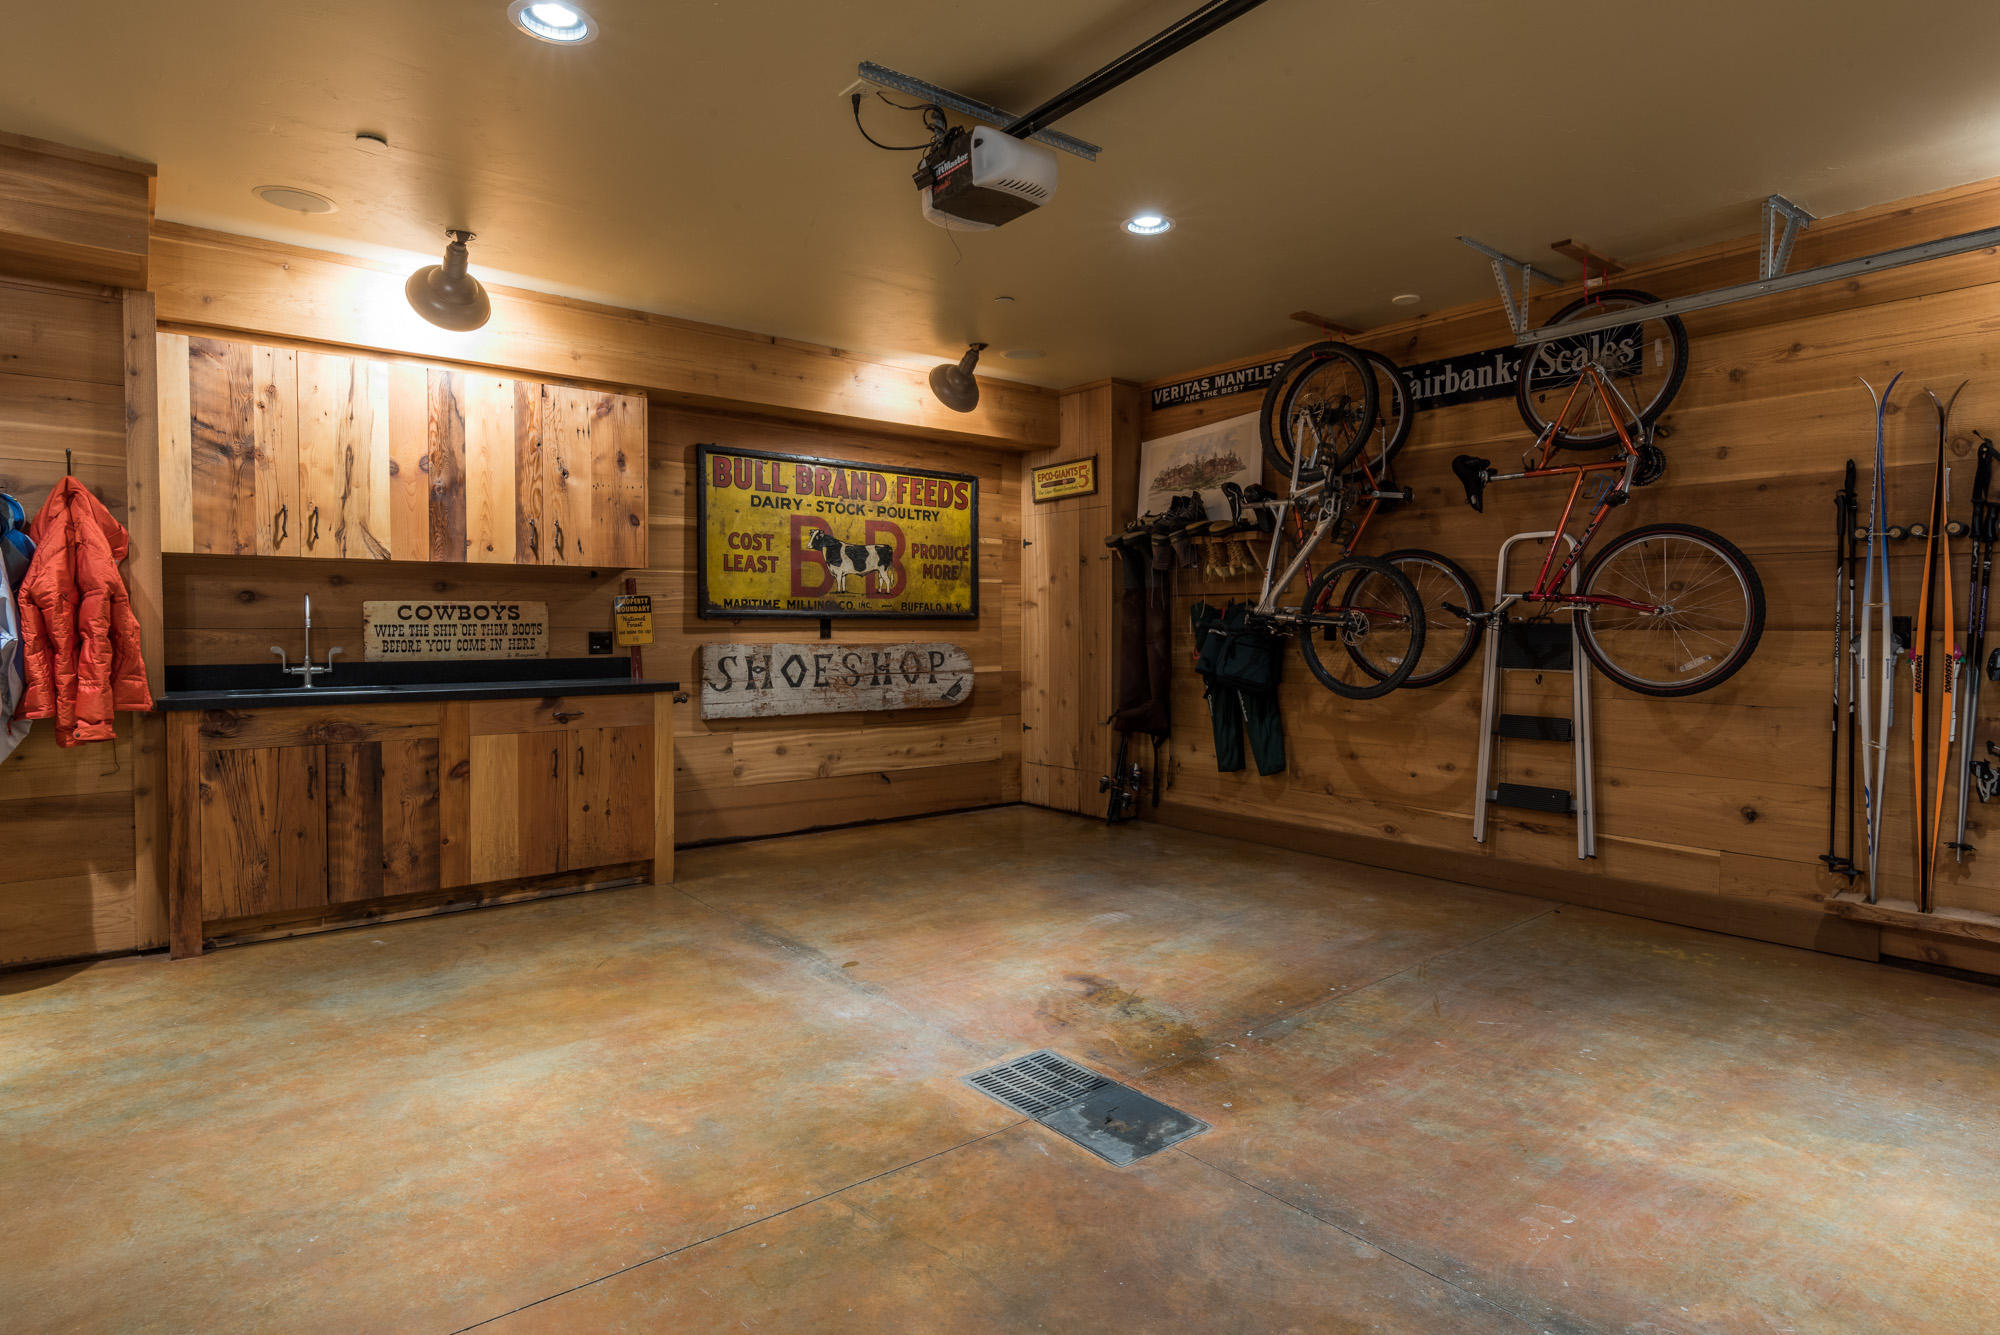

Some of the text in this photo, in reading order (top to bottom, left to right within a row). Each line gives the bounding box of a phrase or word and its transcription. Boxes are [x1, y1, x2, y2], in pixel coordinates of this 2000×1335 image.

[934, 152, 969, 177] iftMaster
[1402, 334, 1635, 401] airbanks Scales
[1153, 363, 1285, 405] VERITAS MANTLES
[1184, 384, 1245, 403] ARE THE BEST
[712, 455, 970, 511] BULL BRAND FEEDS
[750, 494, 941, 522] DAIRY STOCK POULTRY
[727, 531, 775, 551] COST
[790, 514, 907, 600] B B
[911, 542, 970, 563] PRODUCE
[723, 553, 779, 574] LEAST
[922, 562, 960, 581] MORE
[397, 604, 521, 621] COWBOYS
[723, 598, 781, 609] MARITIME
[374, 623, 543, 637] WIPE THE SHIT OFF THEM BOOTS
[382, 638, 536, 653] BEFORE YOU COME IN HERE
[1914, 654, 1923, 694] ROSSIGNOL
[1945, 653, 1953, 694] ROSSIGNOL
